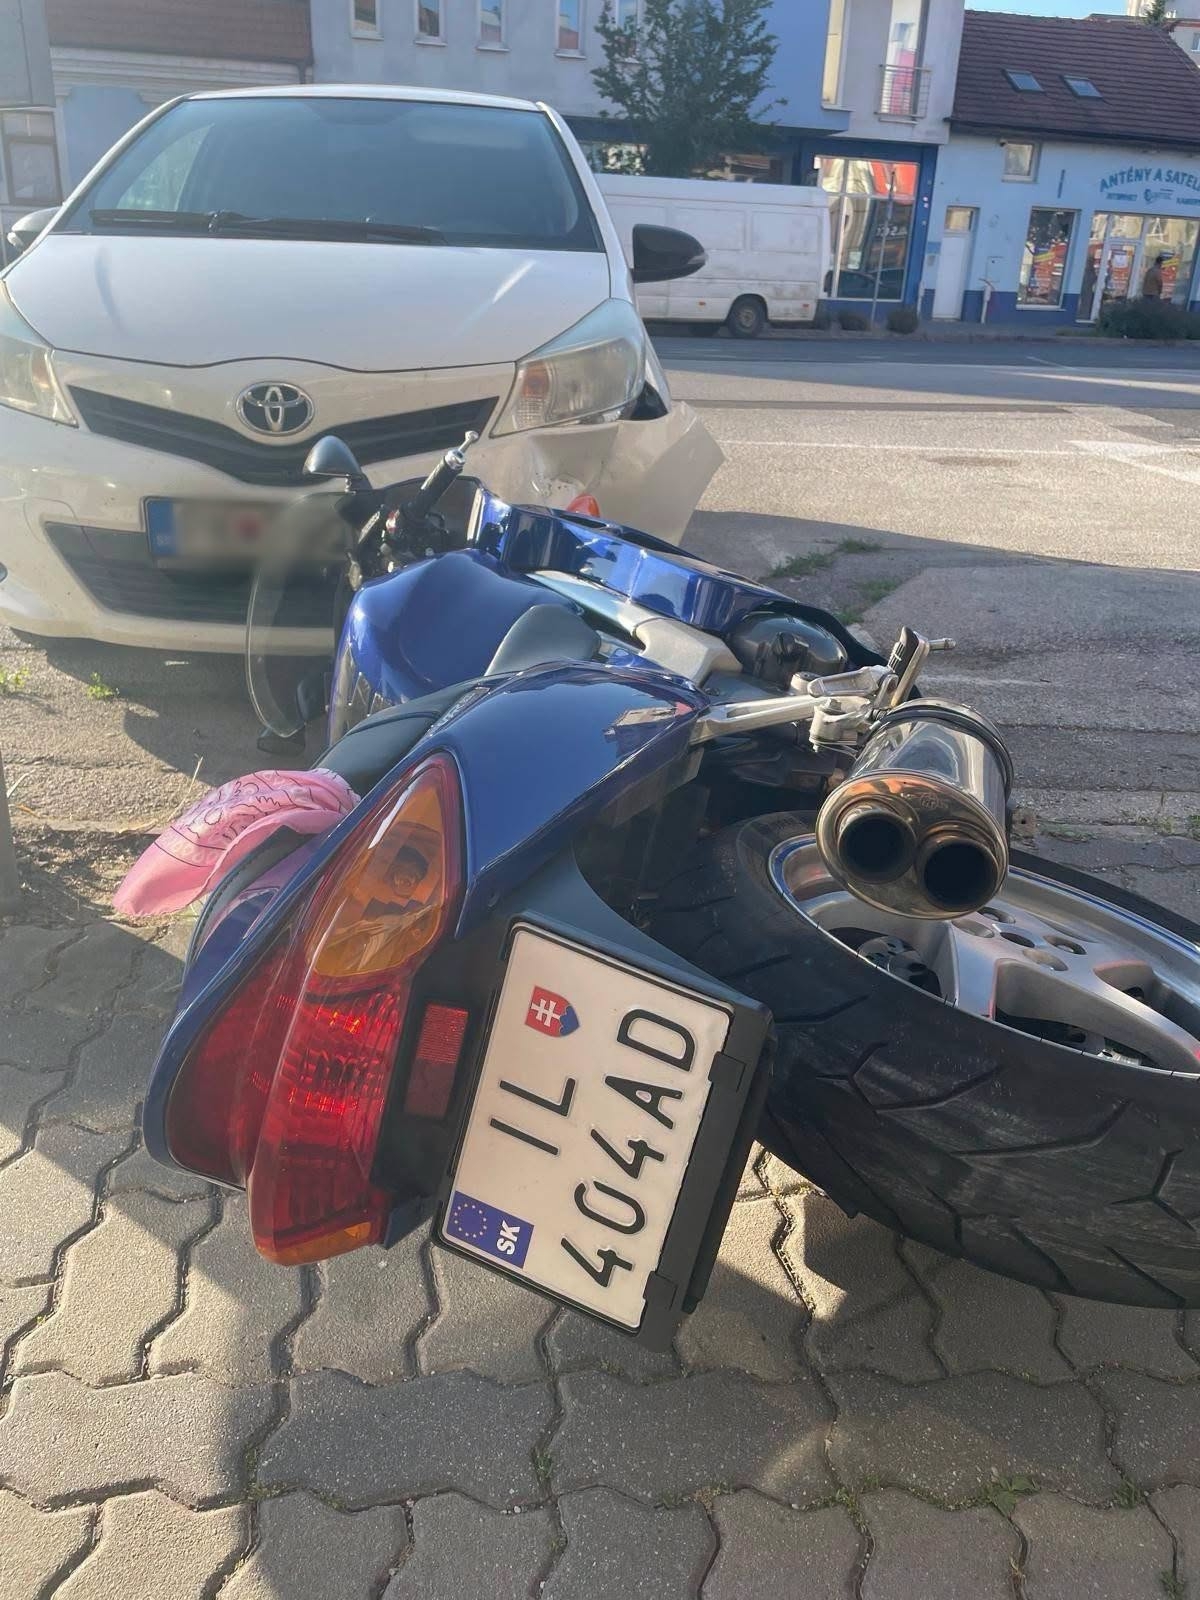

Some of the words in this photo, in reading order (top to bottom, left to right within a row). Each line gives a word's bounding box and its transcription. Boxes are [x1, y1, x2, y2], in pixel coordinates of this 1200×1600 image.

[1100, 166, 1152, 192] ANTÉNY
[1153, 168, 1162, 181] A
[1165, 169, 1200, 192] SATEL
[490, 1077, 576, 1156] IL
[560, 1008, 697, 1288] 404AD
[496, 1220, 521, 1255] SK
